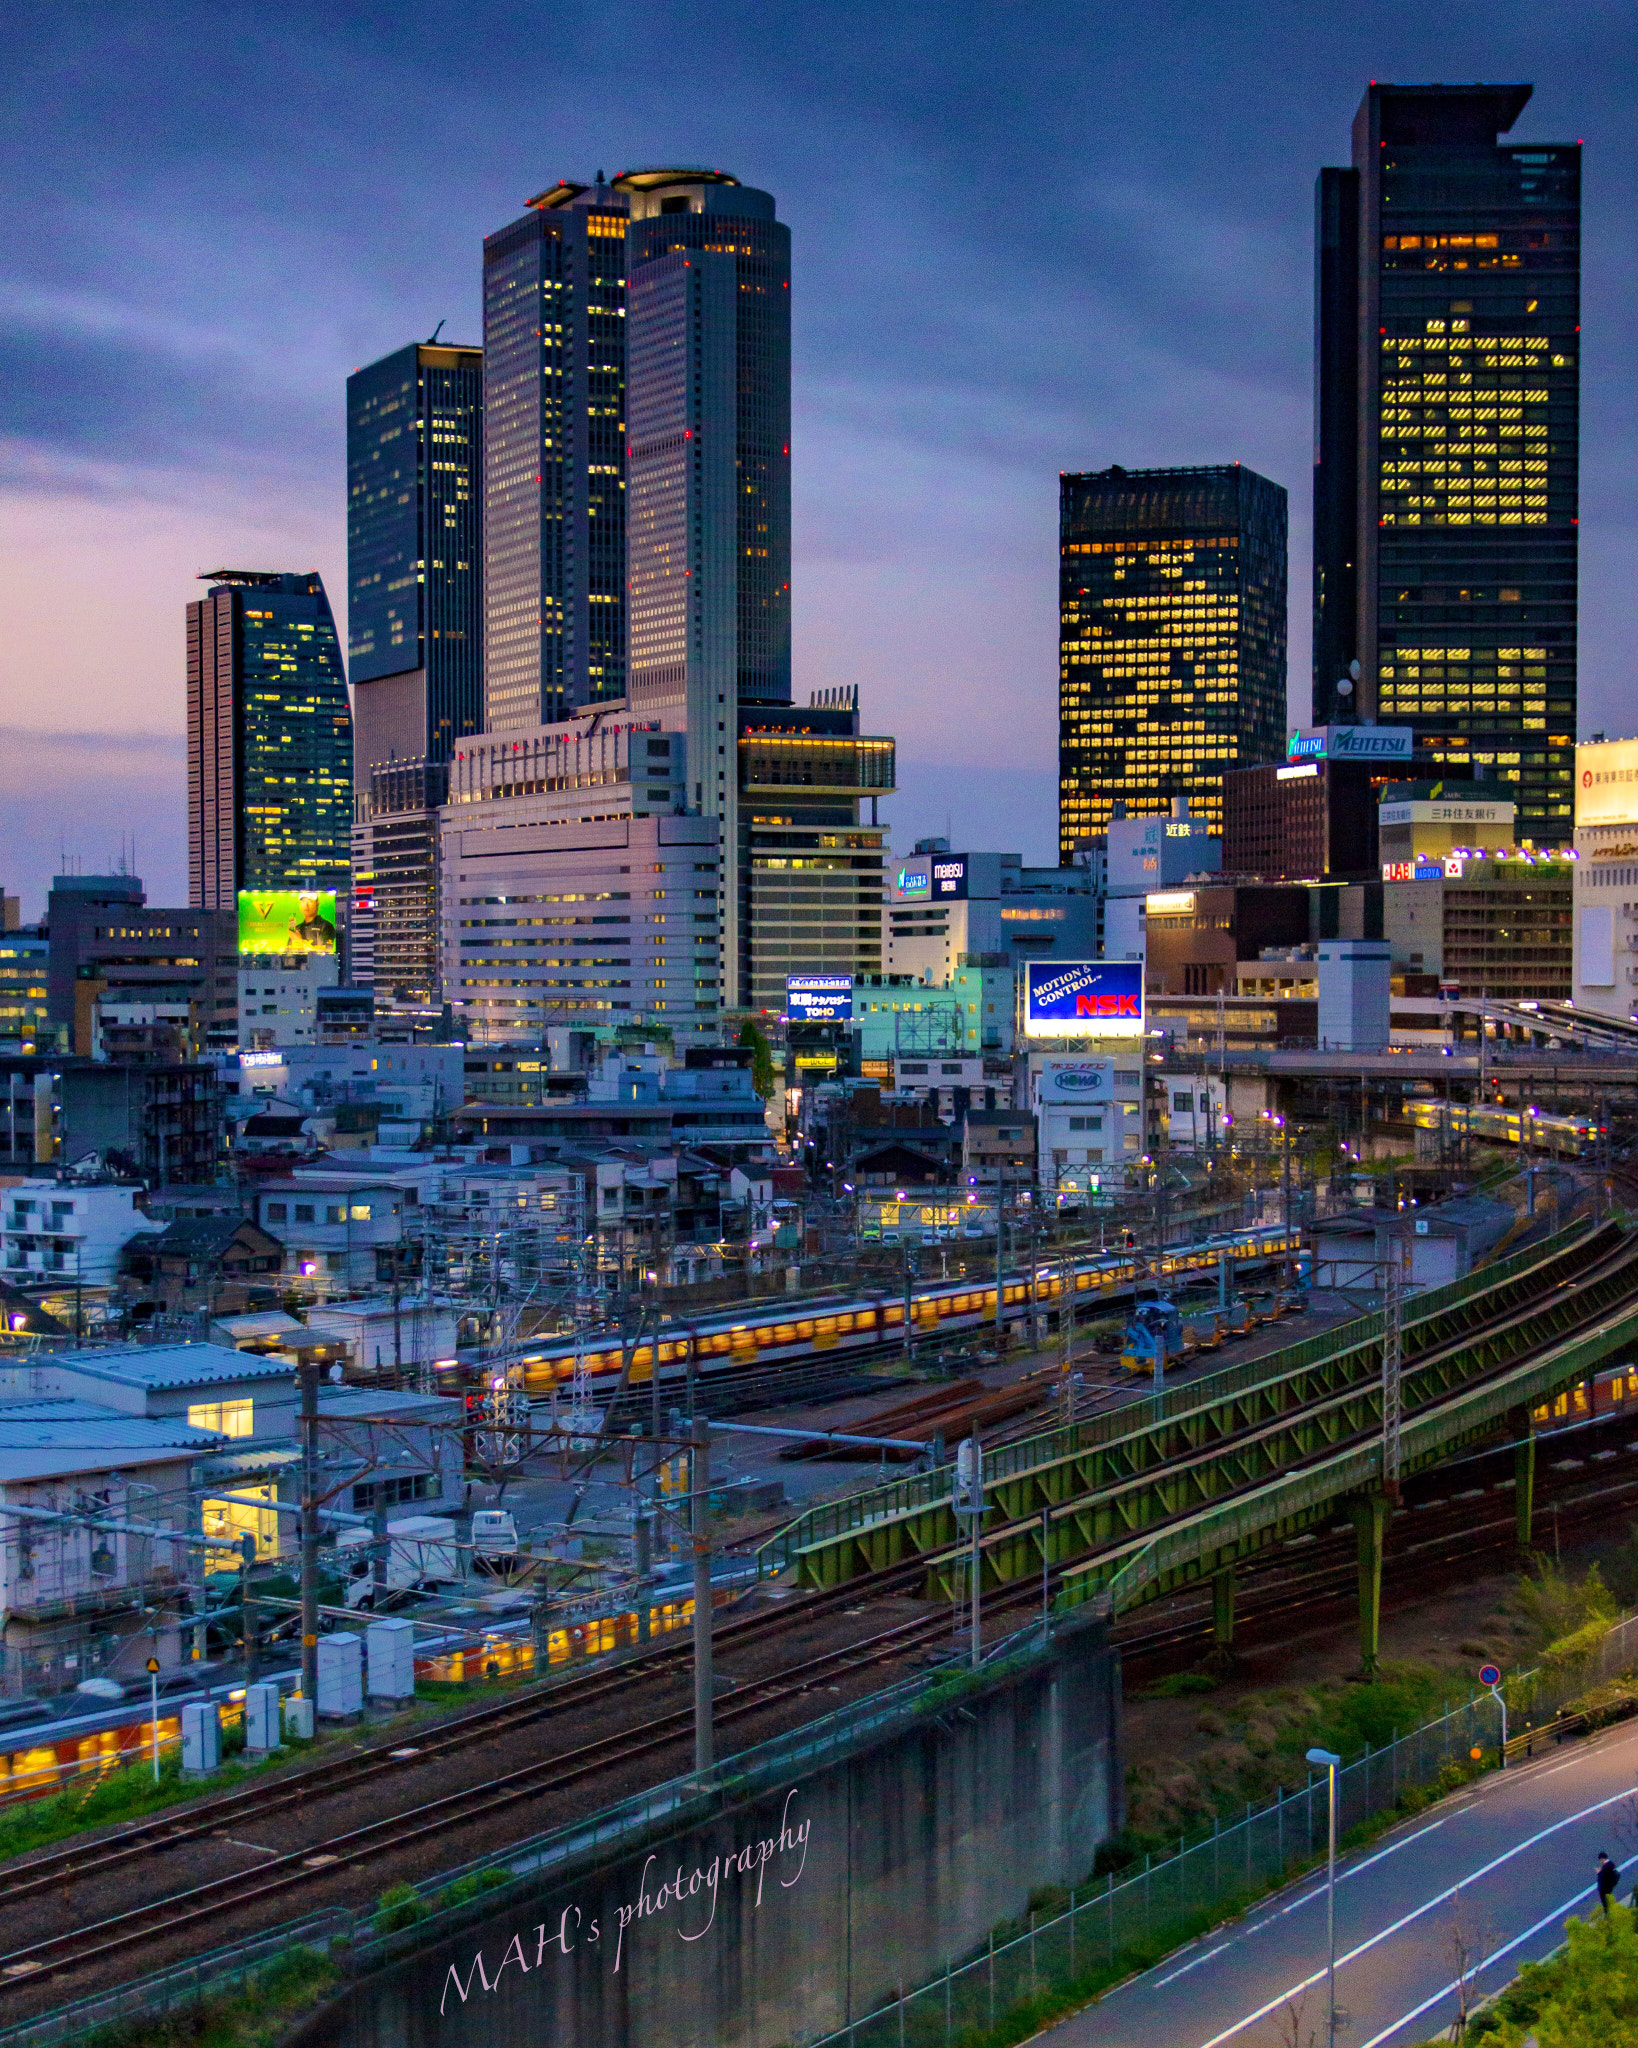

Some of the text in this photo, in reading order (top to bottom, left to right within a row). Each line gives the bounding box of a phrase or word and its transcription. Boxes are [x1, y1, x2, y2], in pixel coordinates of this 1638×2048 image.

[1332, 728, 1406, 752] MEITETSU
[1431, 808, 1496, 820] 三井住友銀行
[1165, 823, 1191, 837] 近鉄
[1032, 964, 1092, 997] MOTION &
[805, 1007, 835, 1017] TOHO
[1076, 994, 1141, 1016] NSK
